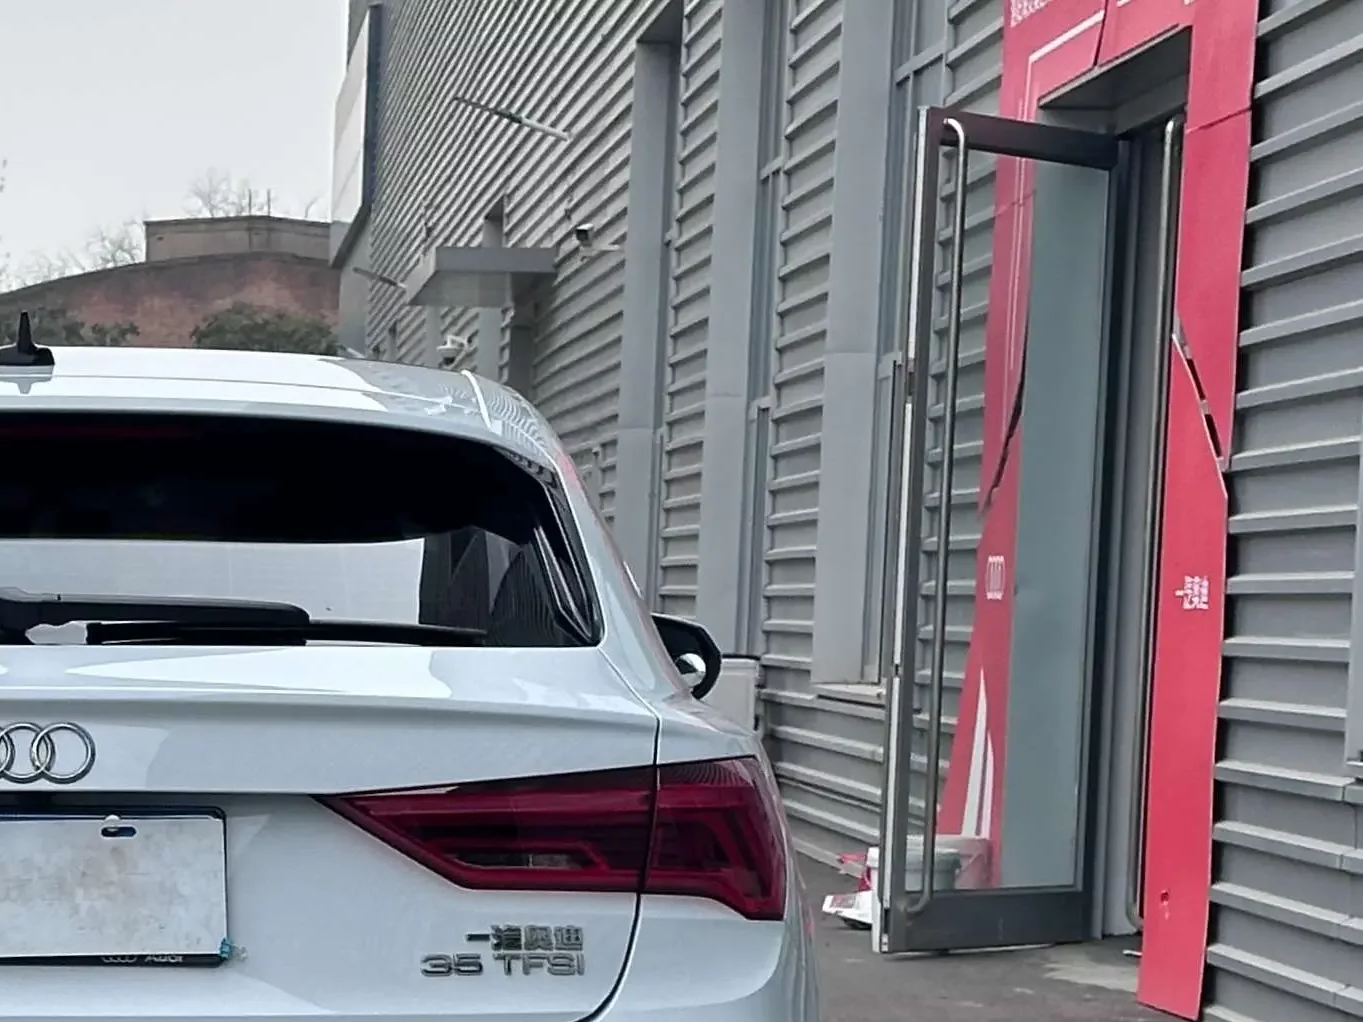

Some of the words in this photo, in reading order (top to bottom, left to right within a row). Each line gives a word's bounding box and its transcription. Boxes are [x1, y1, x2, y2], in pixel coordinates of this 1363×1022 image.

[465, 925, 583, 951] 一汽奥迪
[421, 954, 483, 976] 35
[492, 953, 585, 976] TFSI
